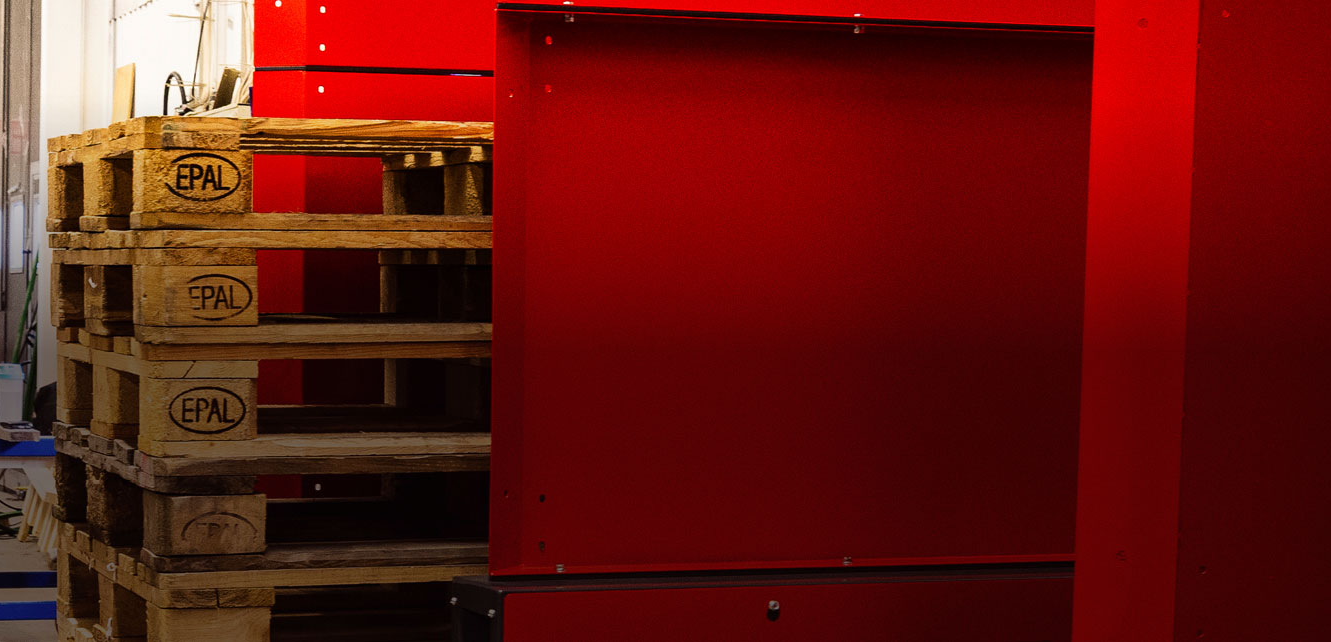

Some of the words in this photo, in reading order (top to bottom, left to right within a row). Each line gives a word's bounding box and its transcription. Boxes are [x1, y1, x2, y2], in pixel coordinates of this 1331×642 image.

[176, 164, 230, 190] EPAL
[189, 285, 242, 310] EPAL
[181, 398, 235, 423] EPAL
